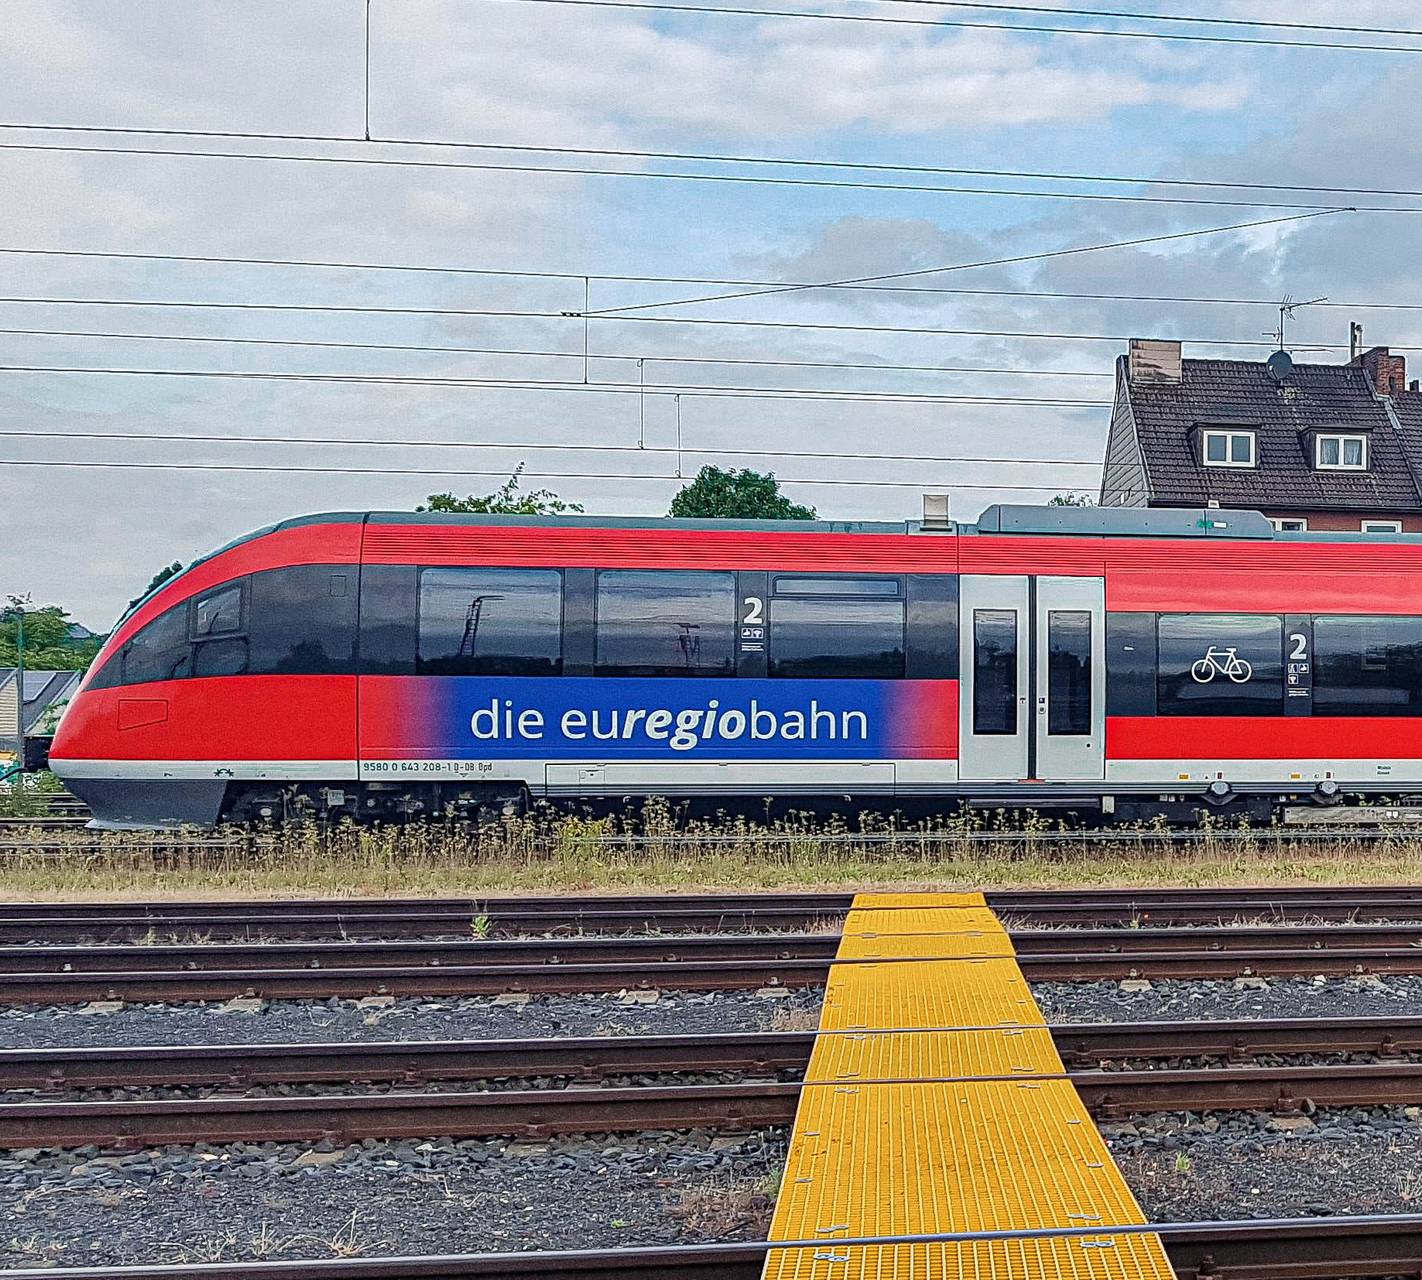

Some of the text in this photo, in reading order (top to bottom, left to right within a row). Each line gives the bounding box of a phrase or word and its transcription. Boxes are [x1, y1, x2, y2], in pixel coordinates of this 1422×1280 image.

[744, 597, 763, 624] 2
[1289, 633, 1307, 660] 2
[470, 699, 868, 751] die euregiobahn
[363, 762, 388, 772] 9580
[391, 762, 398, 772] 0
[401, 762, 420, 772] 643
